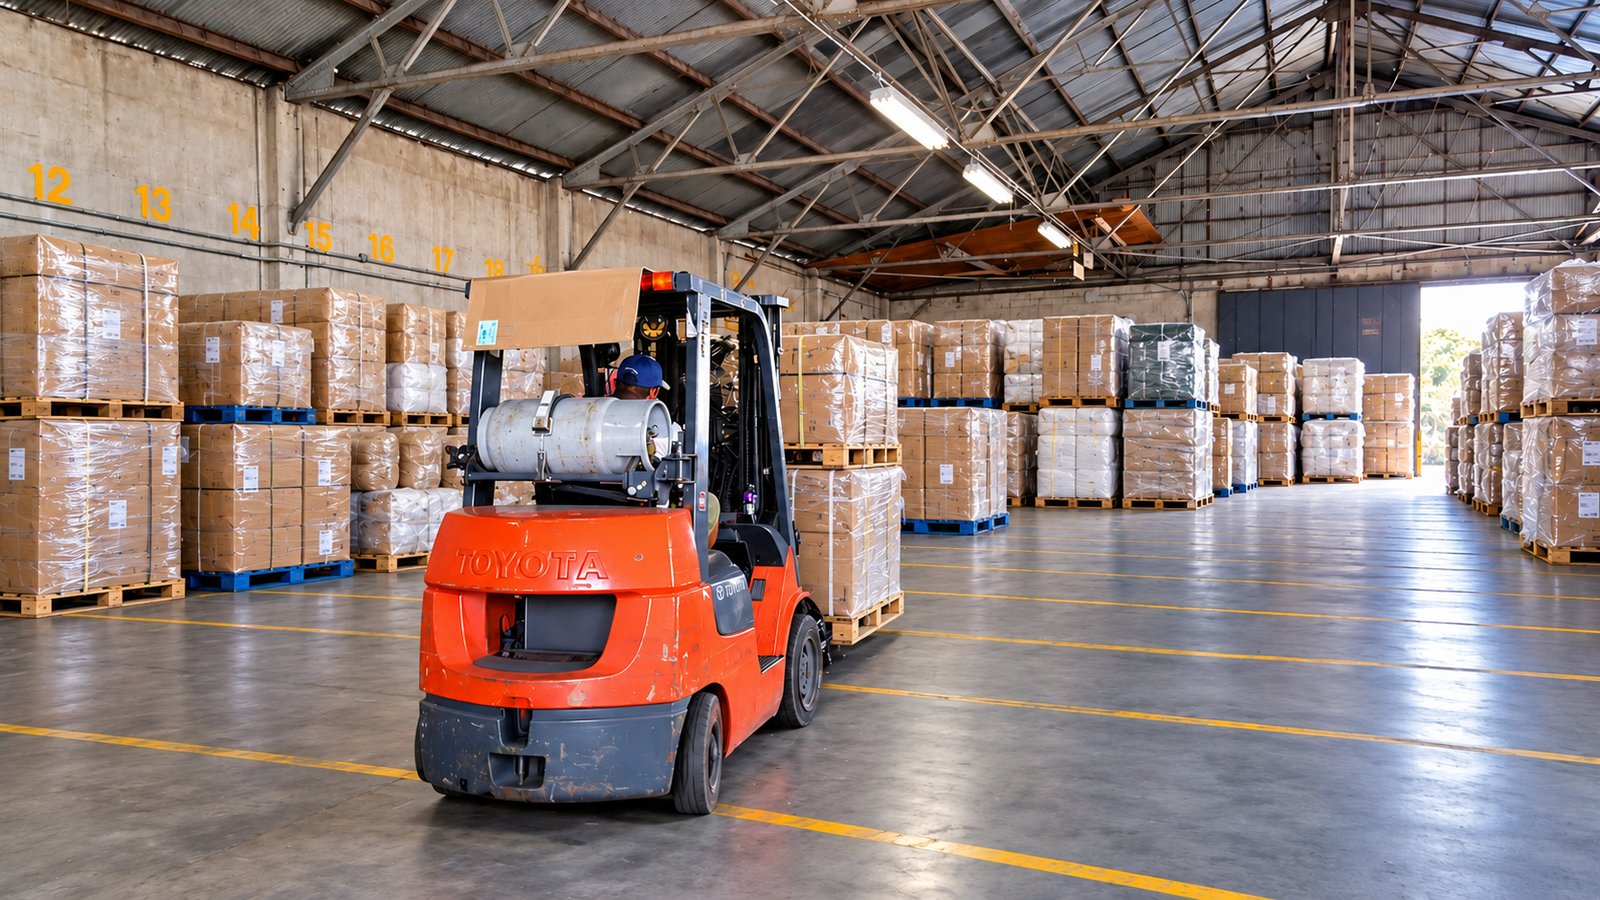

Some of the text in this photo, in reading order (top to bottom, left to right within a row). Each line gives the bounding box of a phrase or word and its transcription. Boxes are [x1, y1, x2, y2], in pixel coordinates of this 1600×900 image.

[28, 163, 72, 205] 12
[135, 184, 172, 222] 13
[227, 202, 261, 241] 14
[304, 220, 333, 253] 15
[368, 233, 395, 263] 16
[431, 246, 455, 273] 17
[484, 258, 505, 279] 18
[456, 549, 609, 581] TOYOTA
